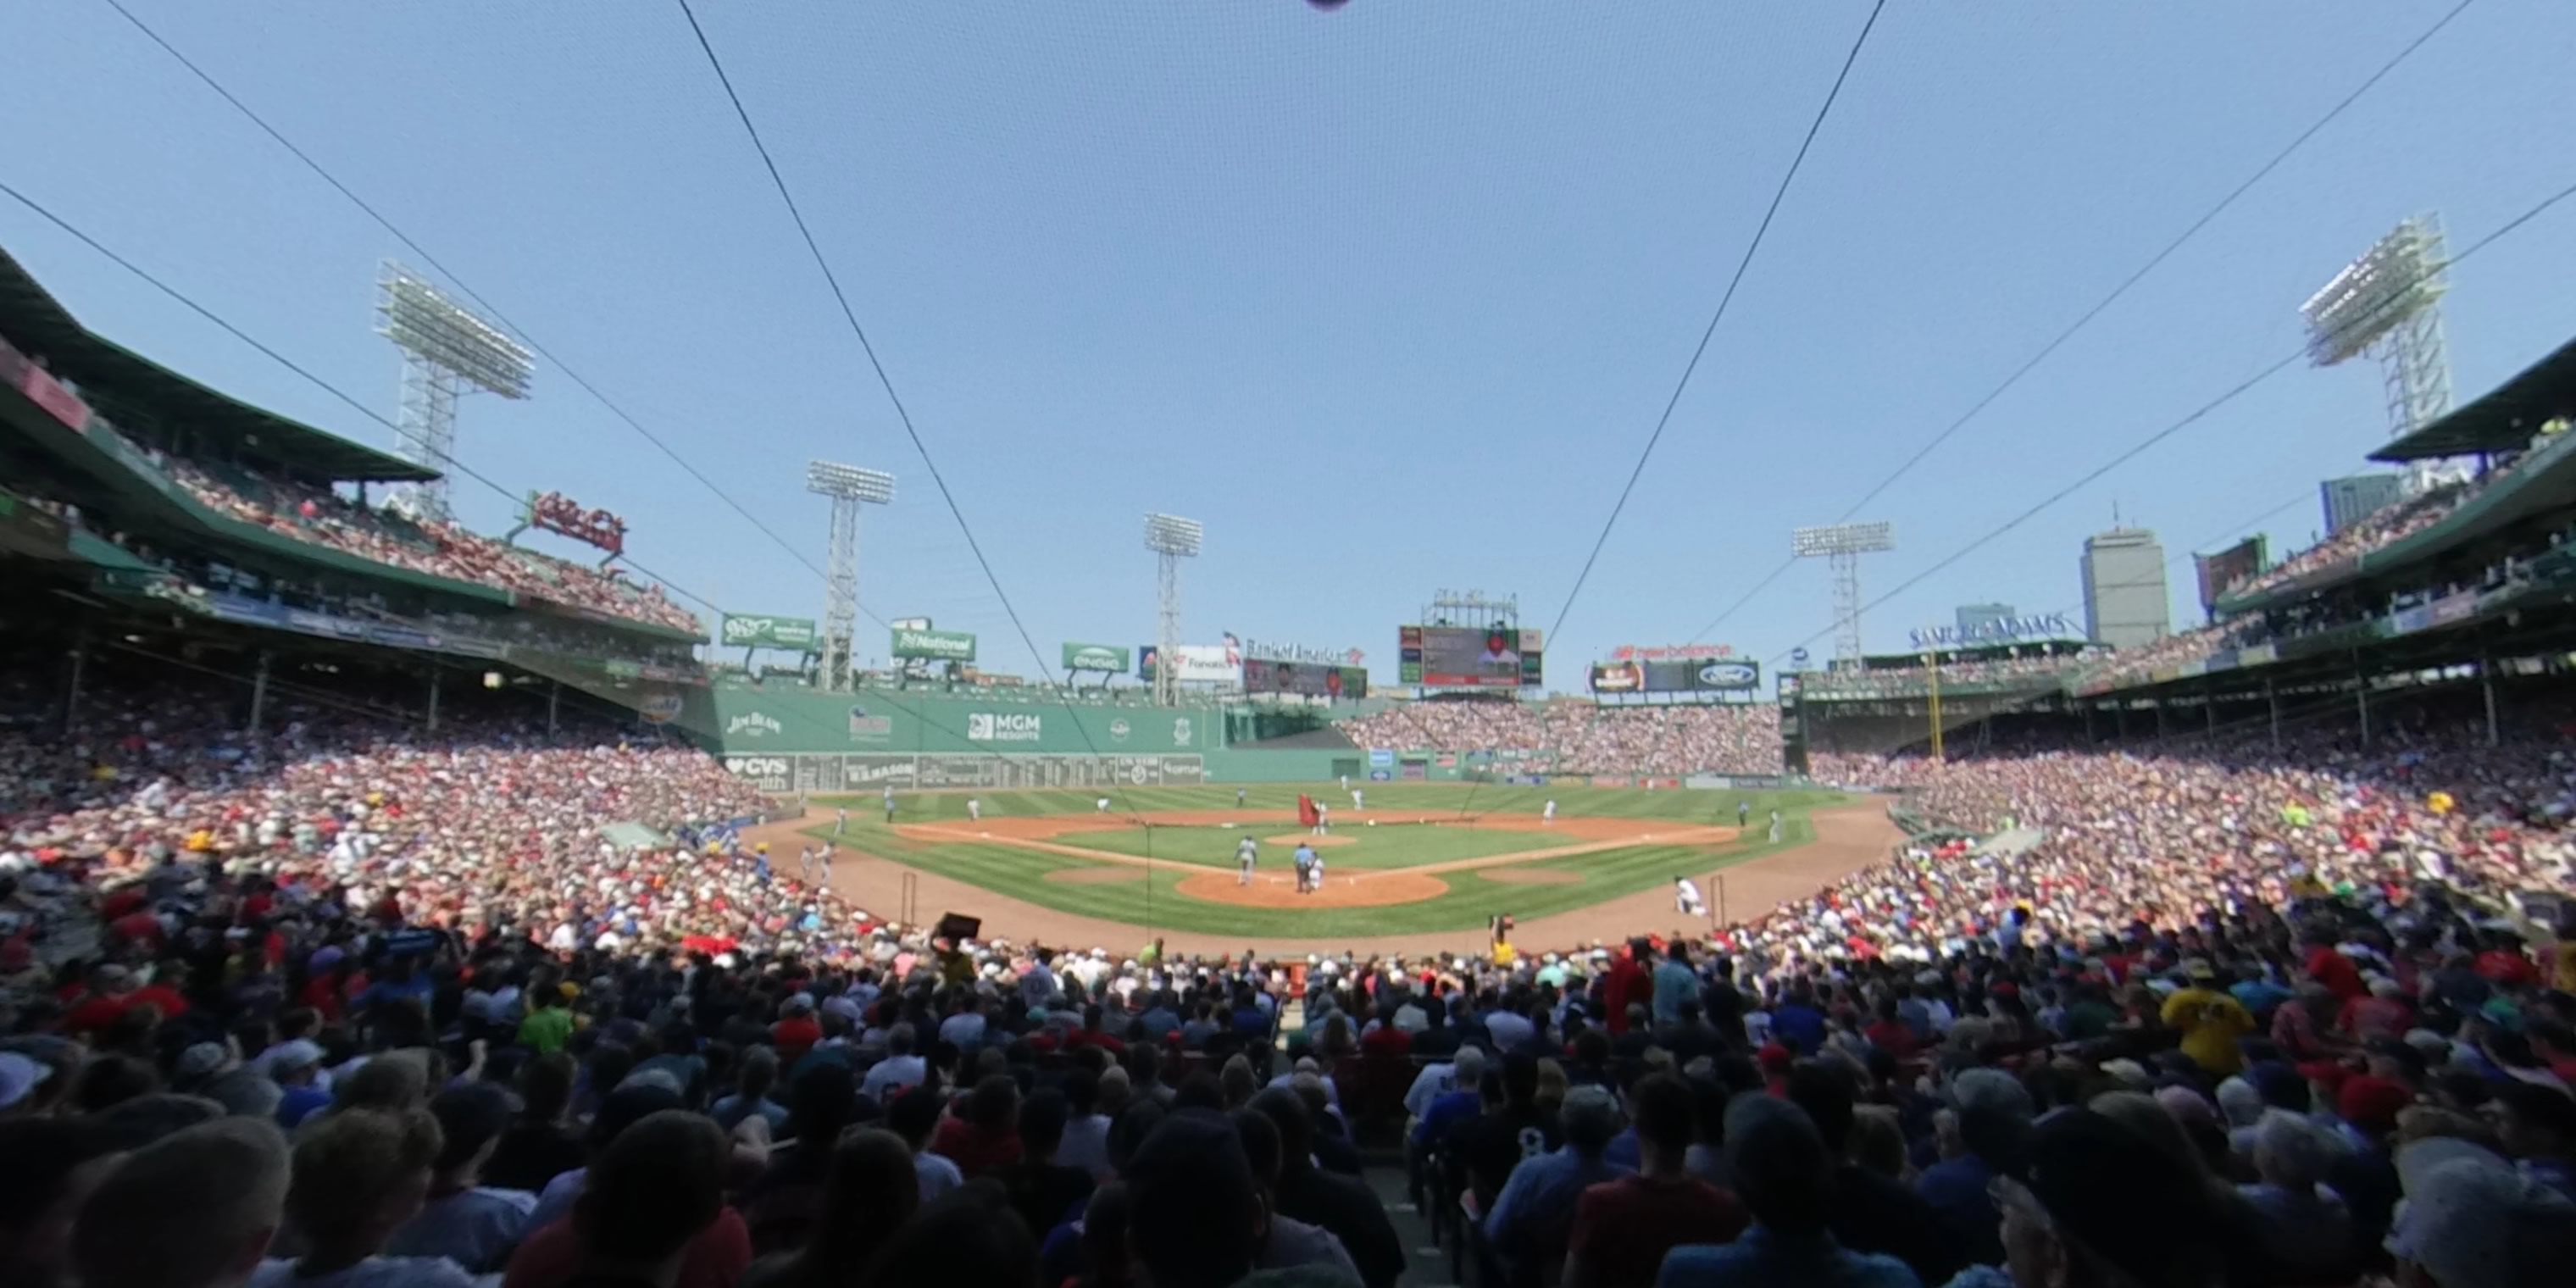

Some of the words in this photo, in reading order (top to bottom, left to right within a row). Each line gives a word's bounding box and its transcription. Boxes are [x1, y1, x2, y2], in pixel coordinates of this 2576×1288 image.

[917, 636, 970, 651] National
[997, 714, 1041, 730] MGM
[746, 758, 788, 774] CVS
